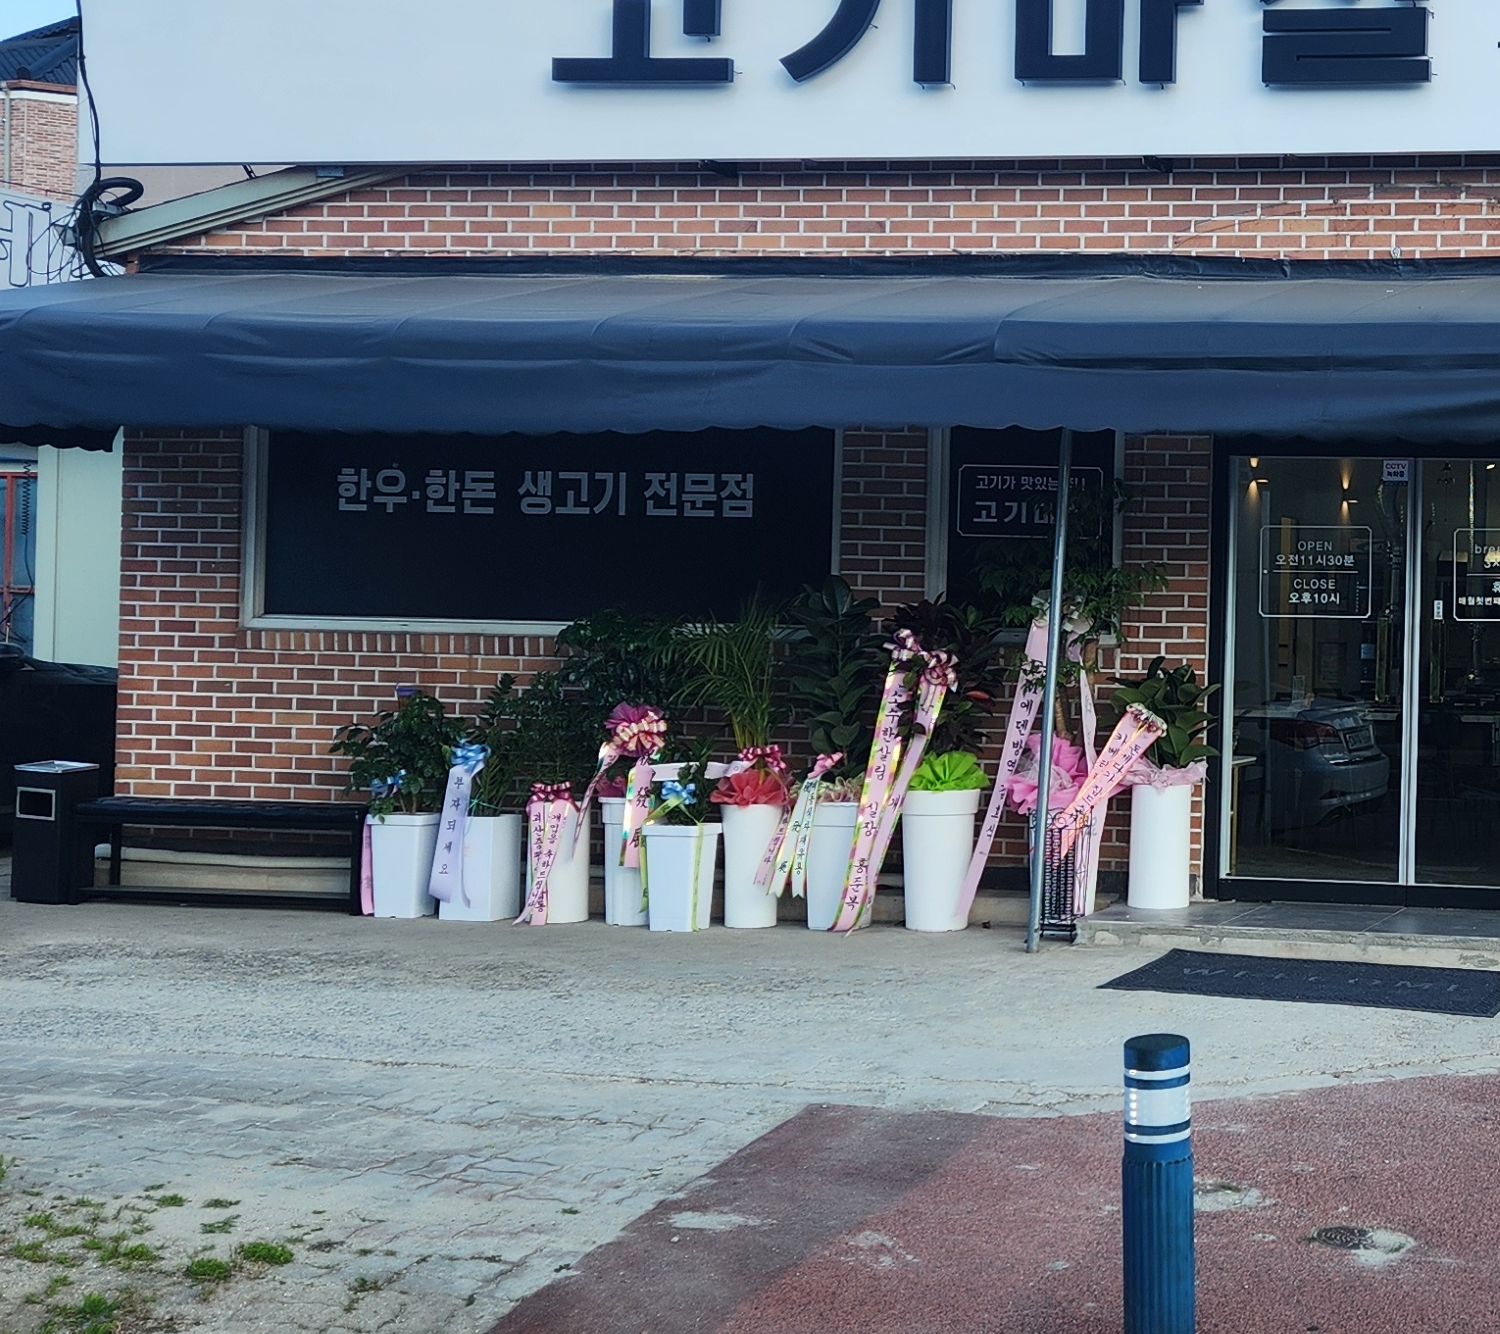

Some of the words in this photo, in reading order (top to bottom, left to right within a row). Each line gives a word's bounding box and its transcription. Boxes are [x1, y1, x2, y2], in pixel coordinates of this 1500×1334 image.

[975, 475, 1017, 490] 고기가
[1020, 476, 1059, 491] 맛있는
[517, 470, 627, 516] 생고기
[643, 472, 755, 517] 전문점
[1297, 541, 1333, 551] OPEN
[1275, 554, 1355, 566] 오전11시30분
[1293, 578, 1336, 589] CLOSE
[1288, 592, 1341, 604] 오후10시
[438, 776, 465, 875] 부자되세요
